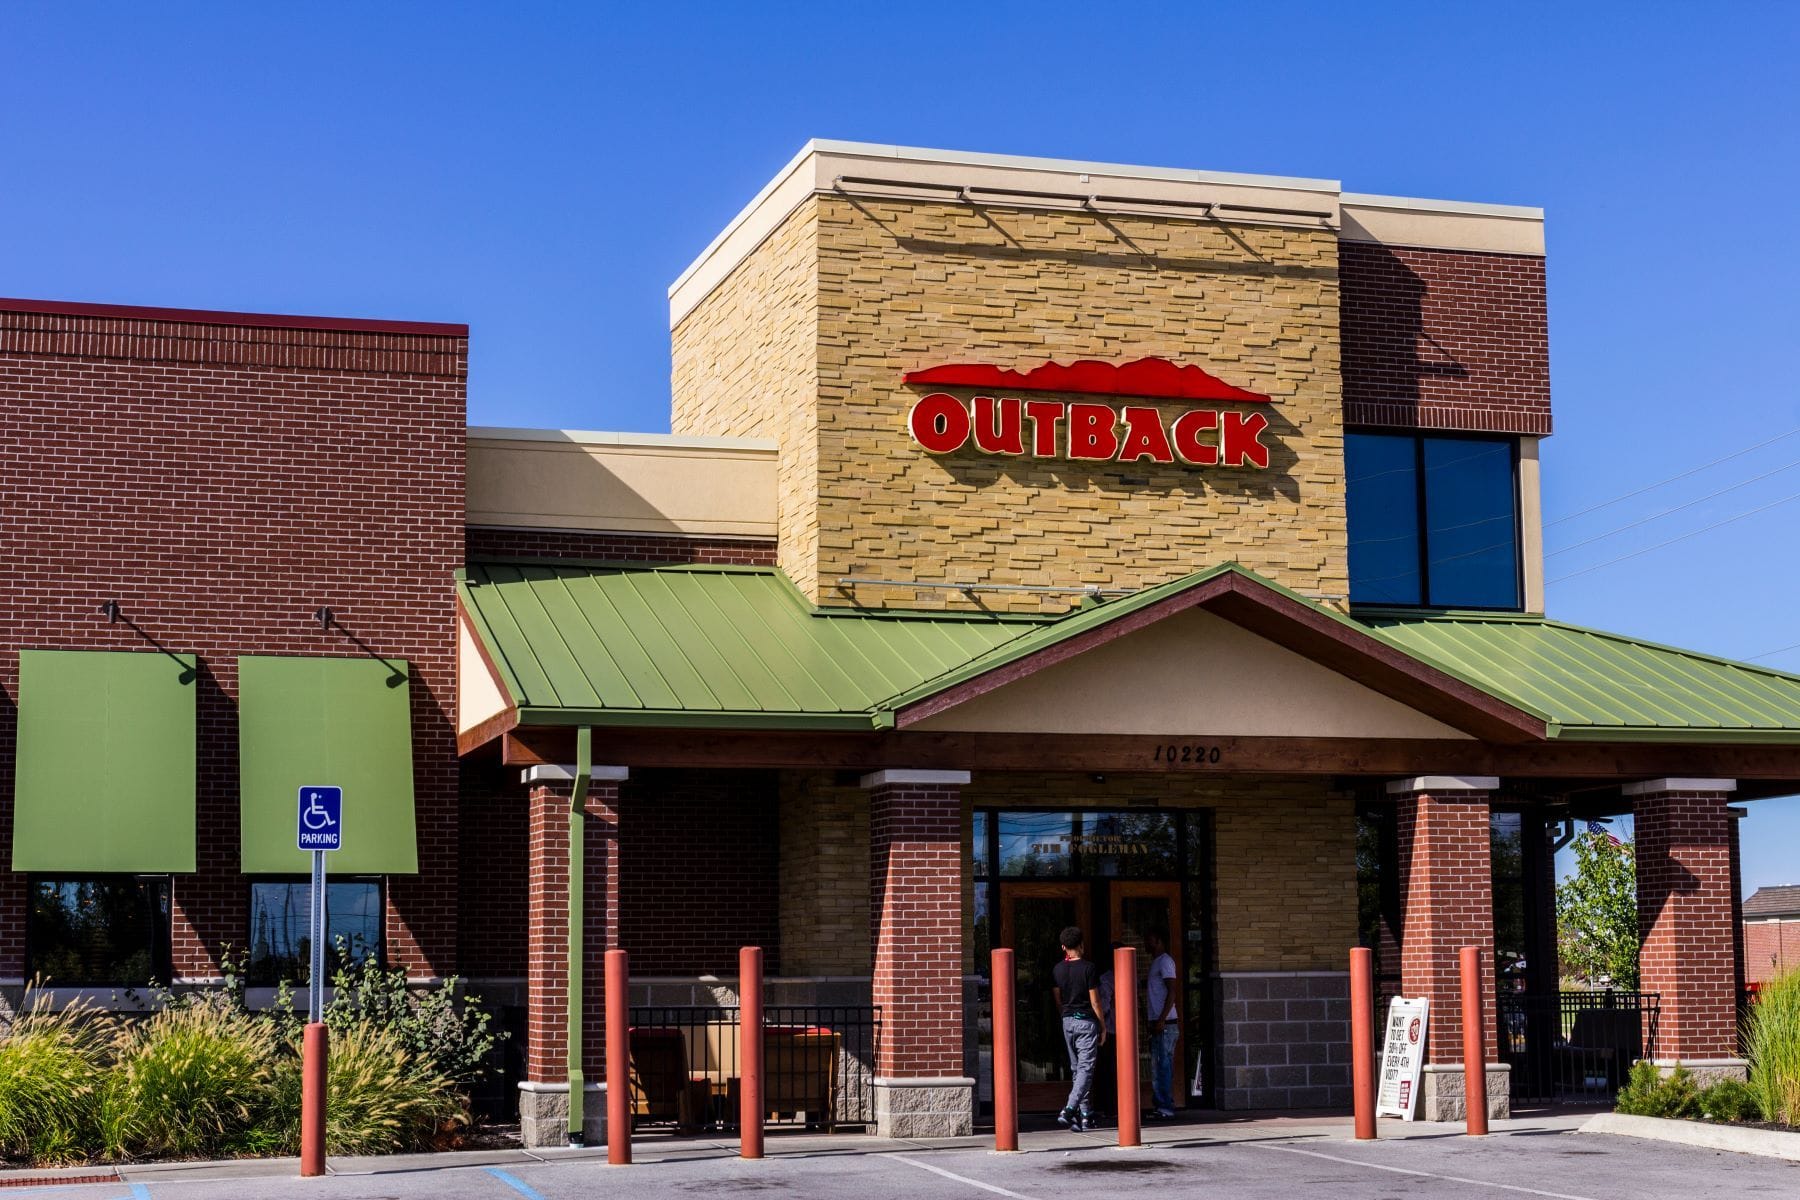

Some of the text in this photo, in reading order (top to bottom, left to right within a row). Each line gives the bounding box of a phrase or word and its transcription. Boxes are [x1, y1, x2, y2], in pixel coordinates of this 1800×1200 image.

[907, 392, 1270, 469] OUTBACK
[1153, 745, 1220, 763] 10220
[301, 833, 338, 844] PARKING
[1032, 844, 1060, 854] TIM
[1392, 1016, 1405, 1028] WANT
[1390, 1029, 1397, 1041] TO
[1397, 1029, 1405, 1041] GET
[1398, 1043, 1408, 1055] OFF
[1387, 1055, 1409, 1068] EVERY 4TH
